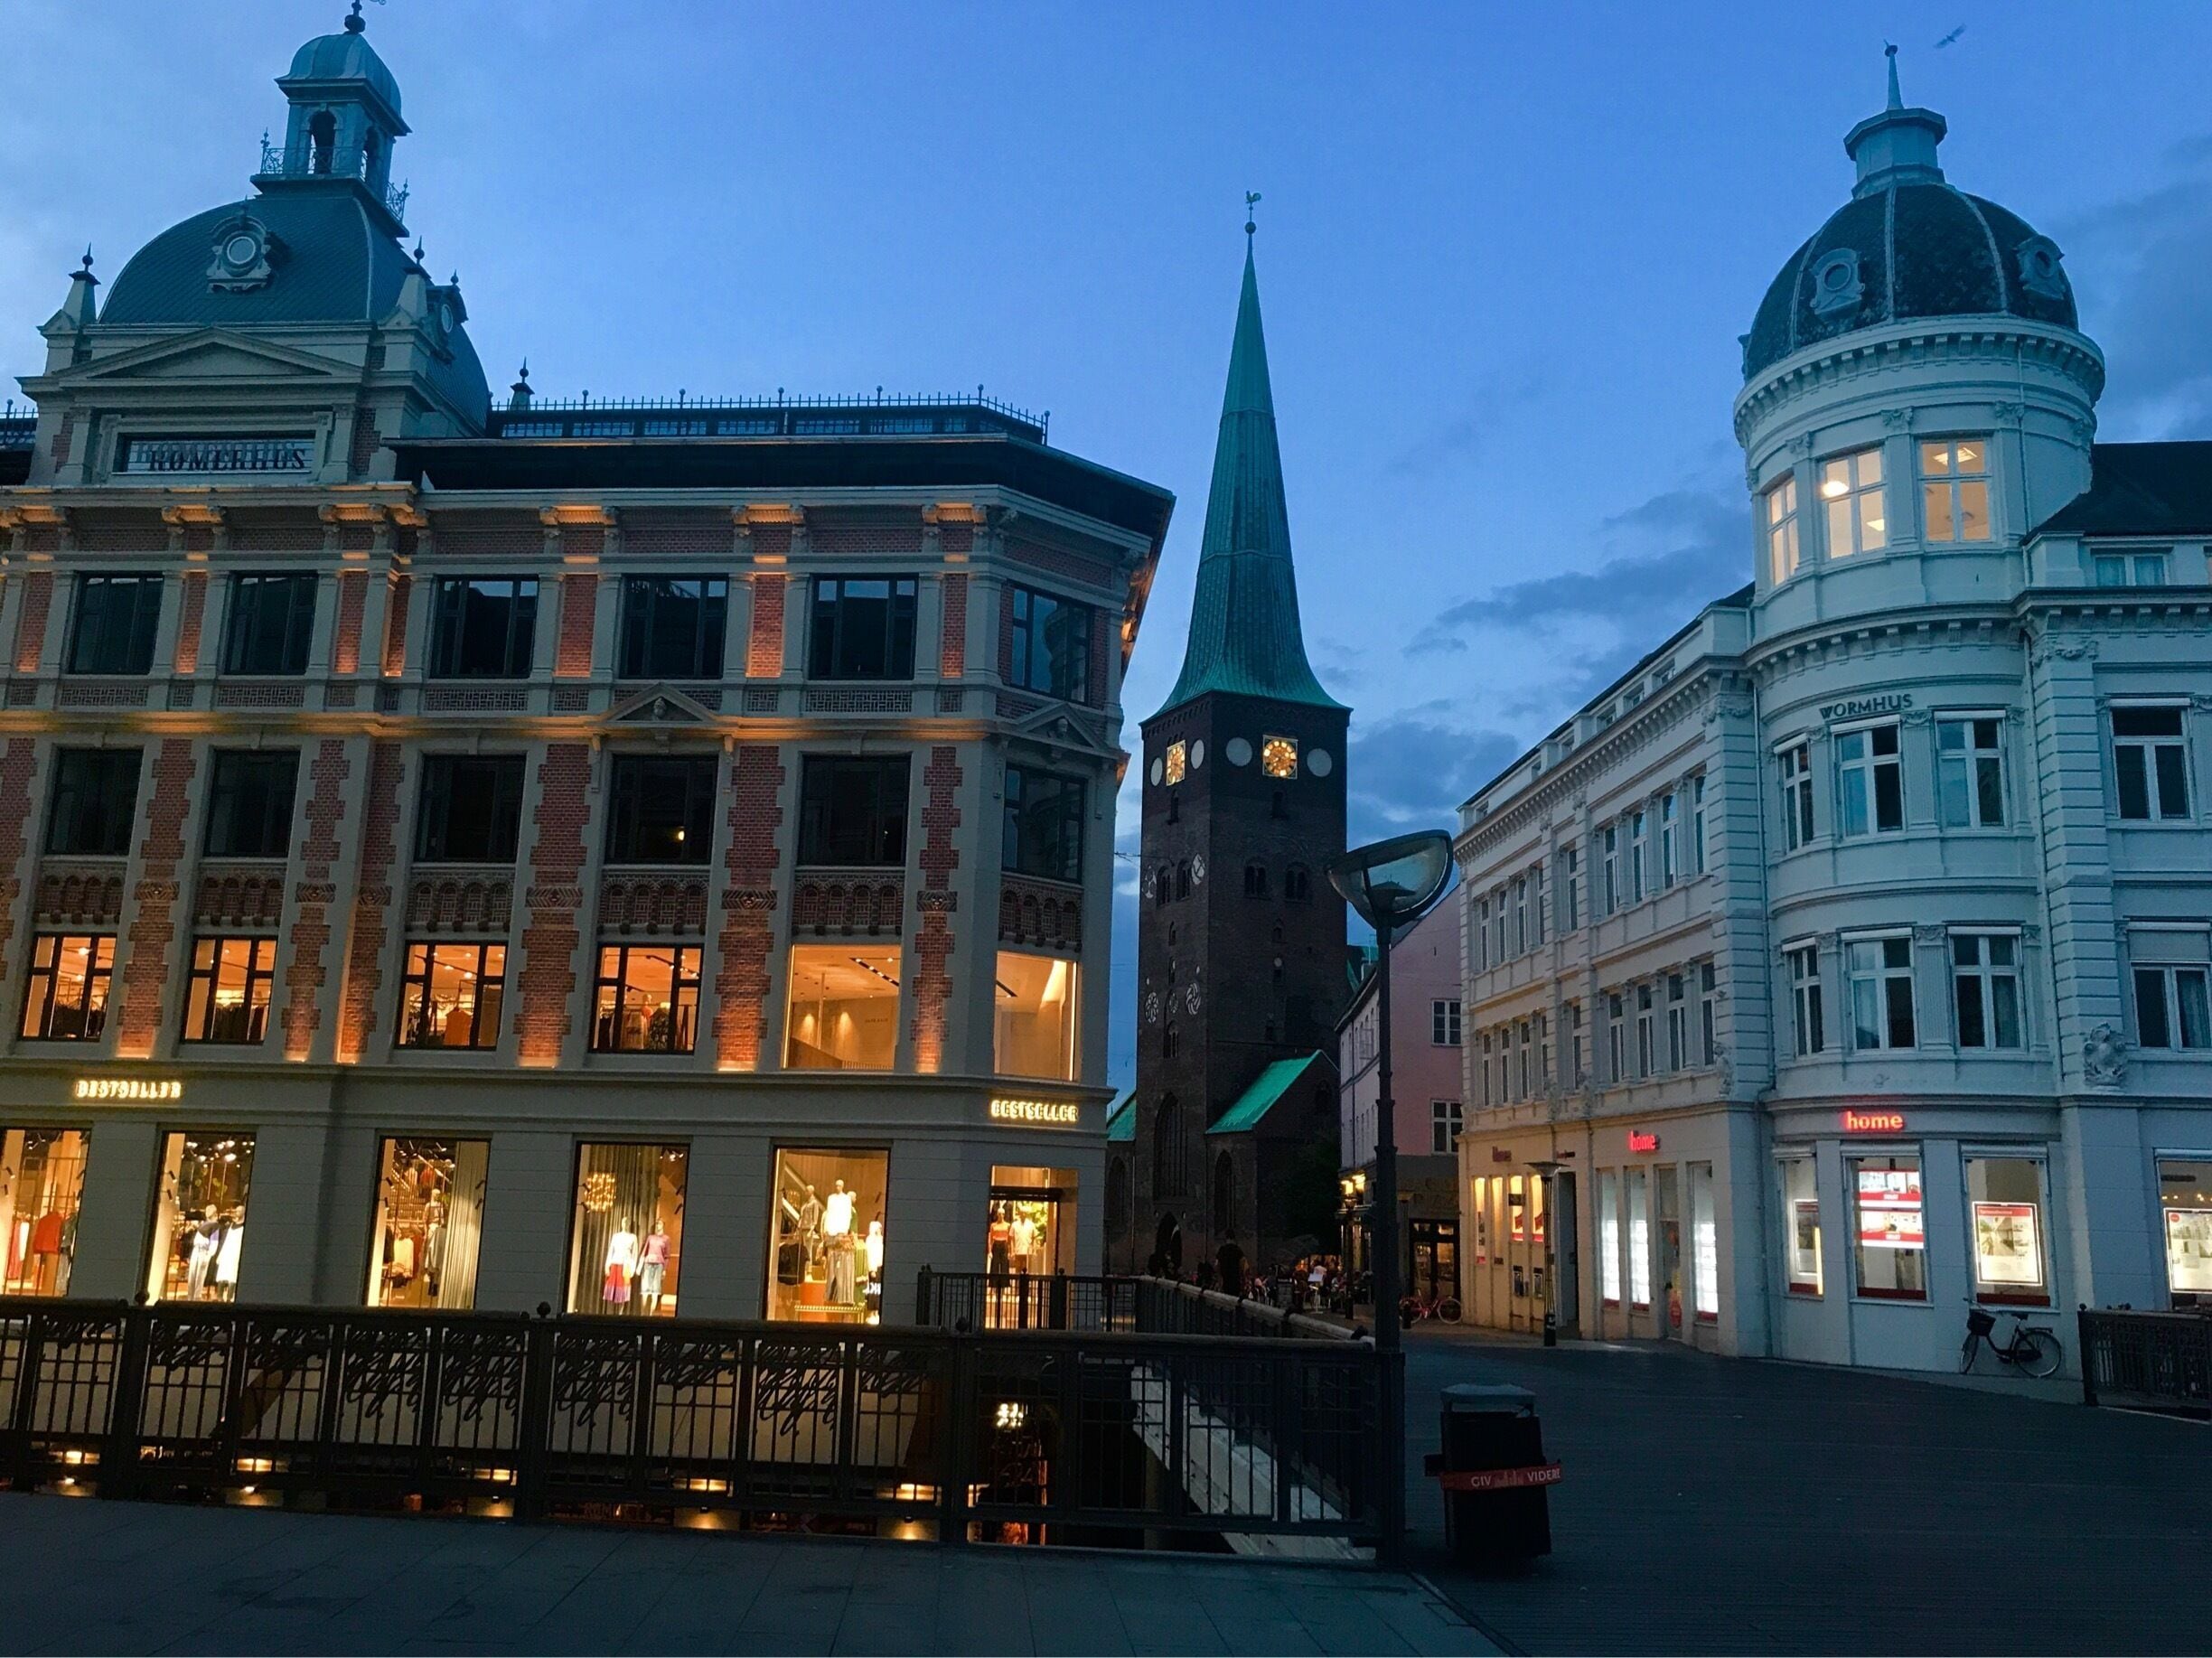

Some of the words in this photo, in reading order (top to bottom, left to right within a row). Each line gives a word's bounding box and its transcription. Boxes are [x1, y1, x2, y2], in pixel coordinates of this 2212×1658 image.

[1819, 693, 1913, 720] WORMHUS
[75, 1080, 183, 1099] BESTSELLER
[990, 1100, 1079, 1122] BESTSELLER
[1846, 1110, 1904, 1129] home
[1627, 1129, 1658, 1151] home
[1470, 1475, 1493, 1487] GIV
